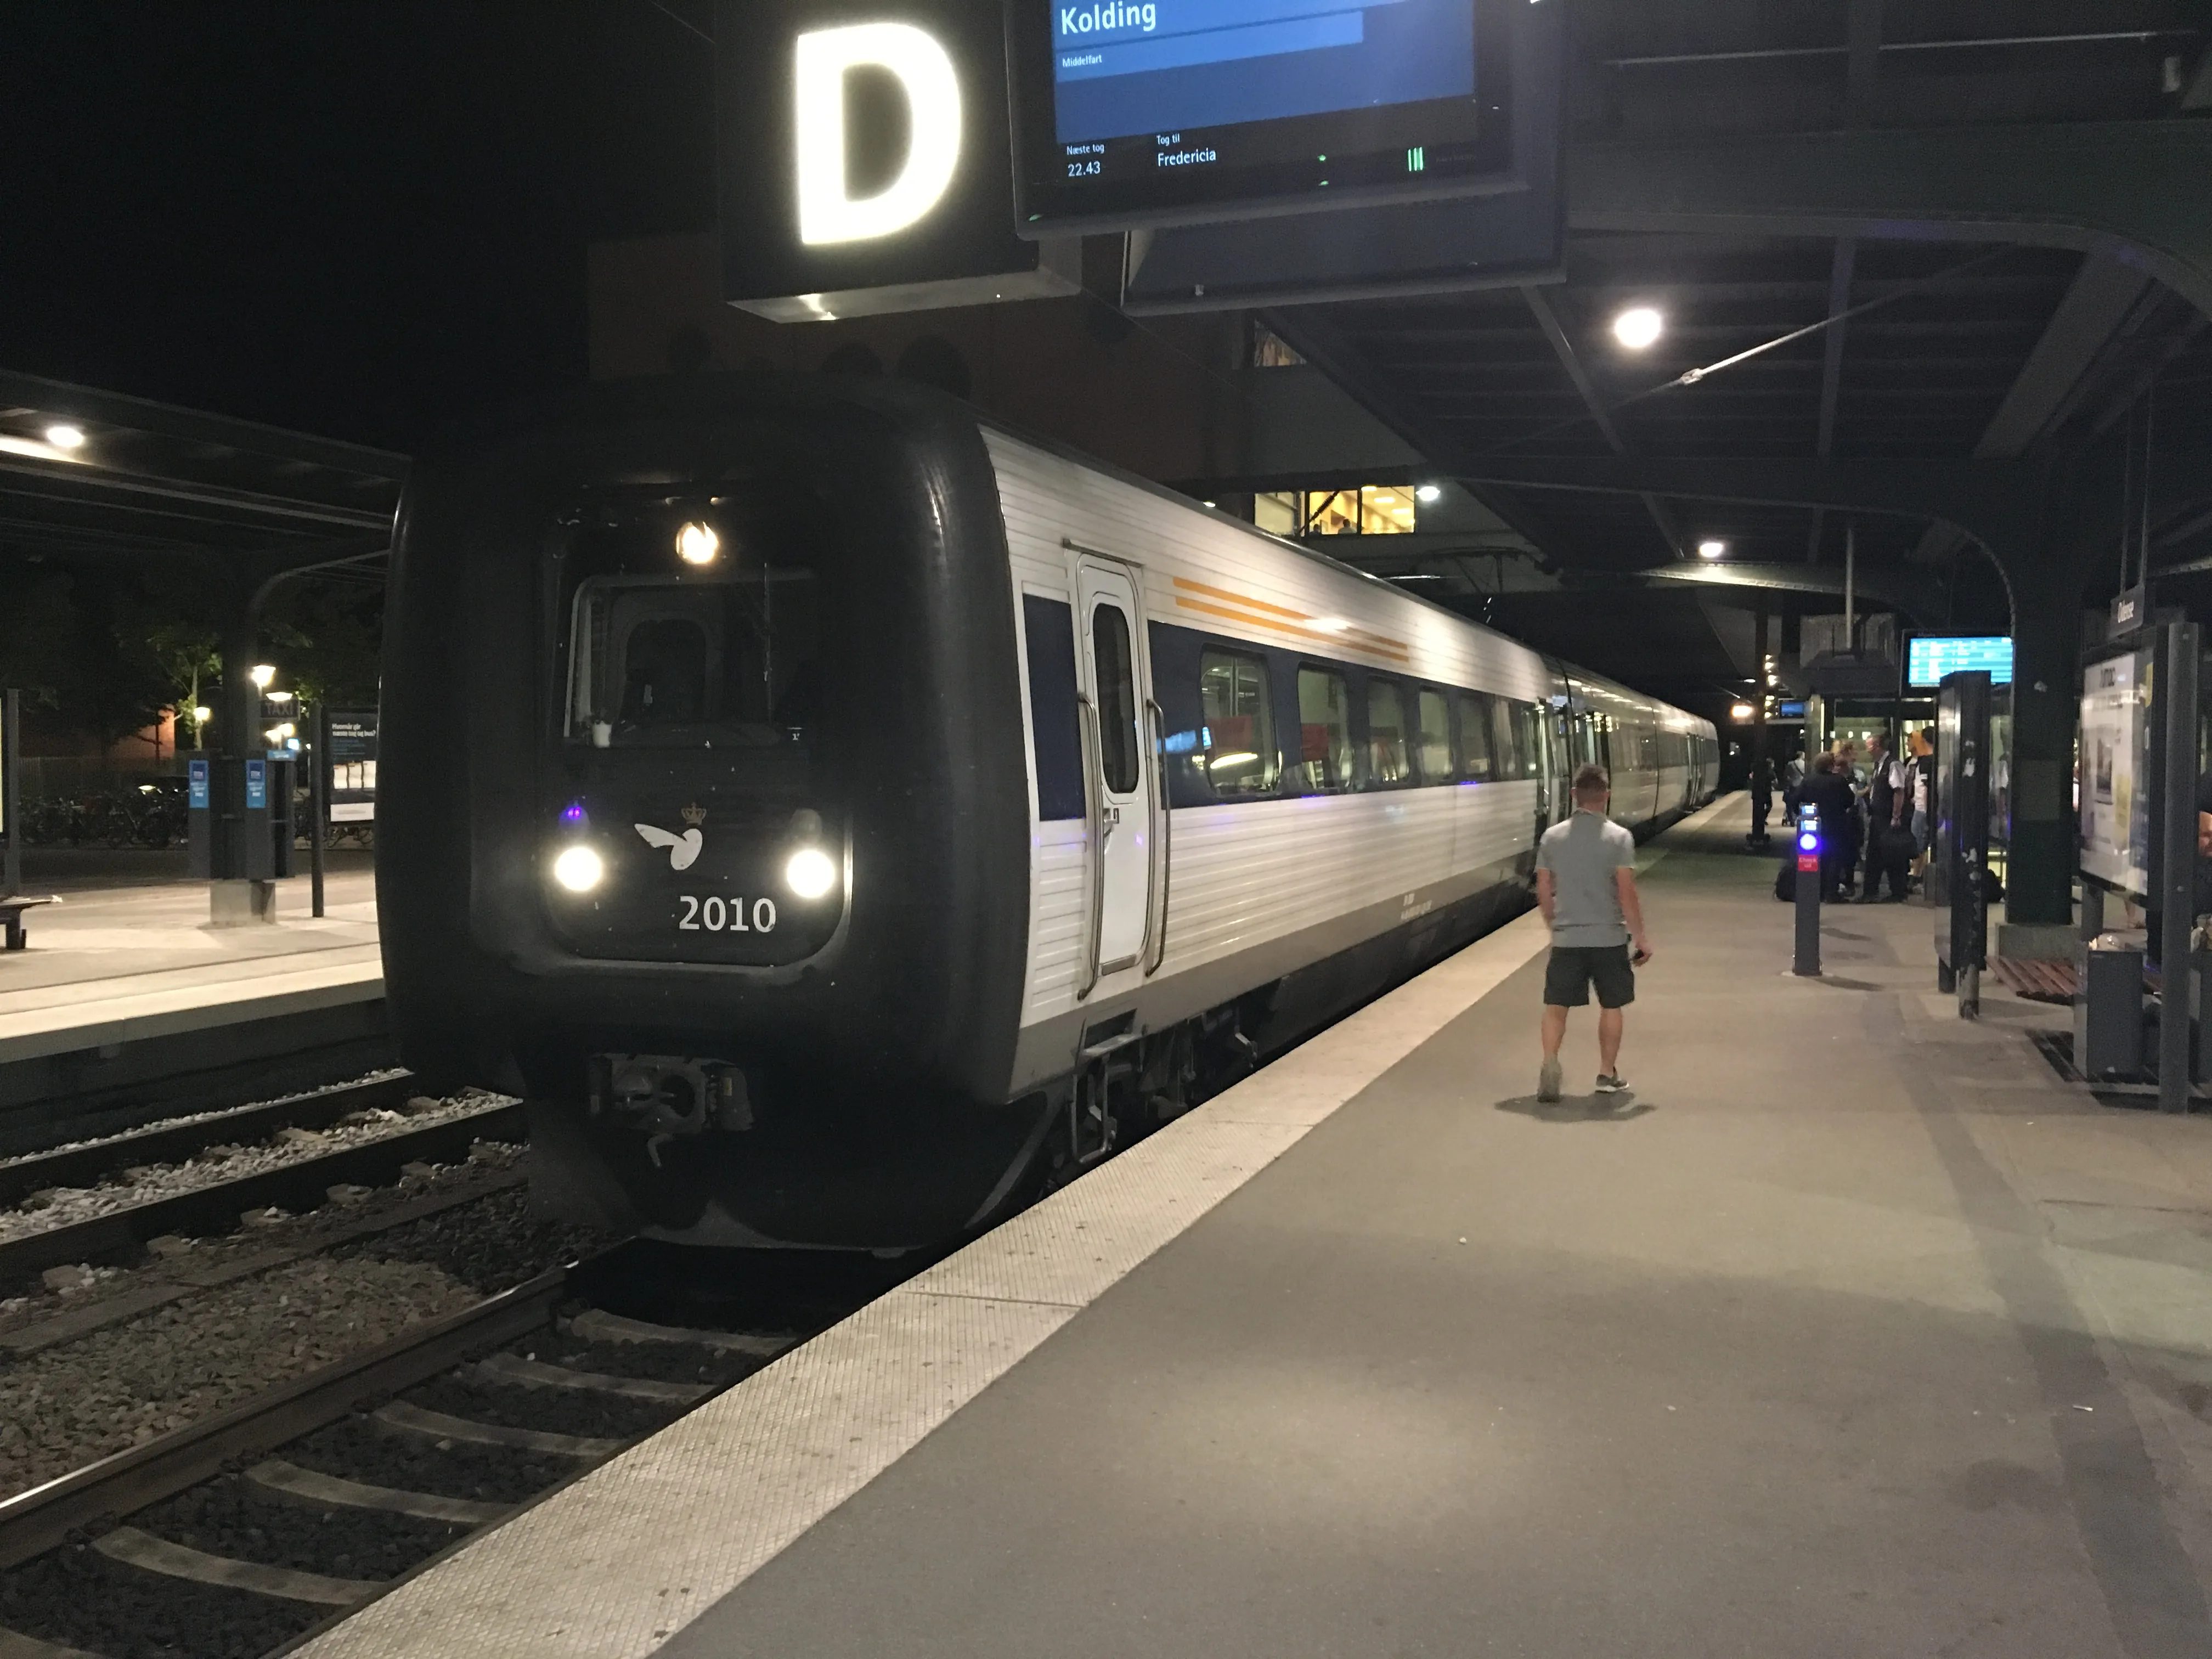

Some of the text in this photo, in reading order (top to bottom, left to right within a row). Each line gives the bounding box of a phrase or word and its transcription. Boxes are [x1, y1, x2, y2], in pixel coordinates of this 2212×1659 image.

[1061, 1, 1156, 35] Kolding
[1062, 54, 1102, 68] Middelfart
[795, 22, 962, 245] D
[1156, 133, 1180, 146] Tog til
[1066, 143, 1105, 156] Næste tog
[1158, 147, 1217, 167] Fredericia
[1068, 161, 1101, 177] 22.43
[679, 895, 777, 933] 2010
